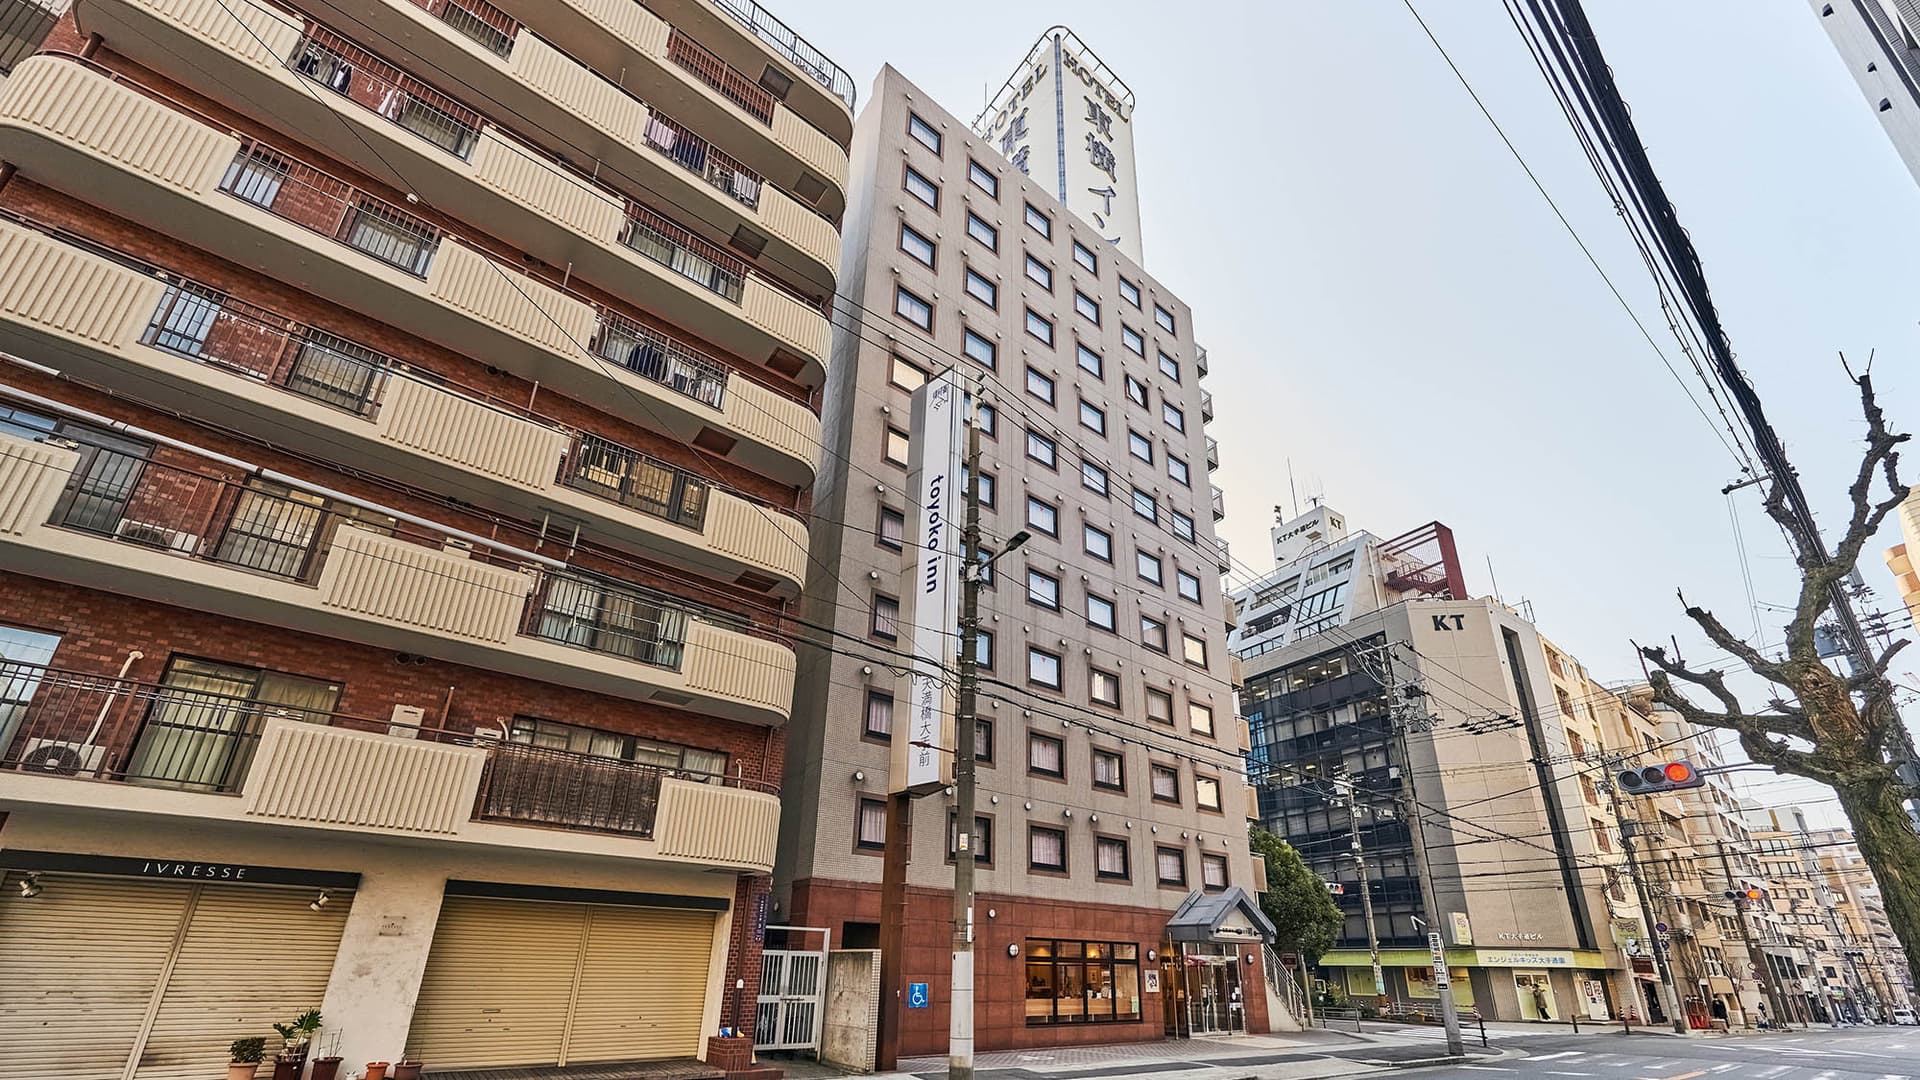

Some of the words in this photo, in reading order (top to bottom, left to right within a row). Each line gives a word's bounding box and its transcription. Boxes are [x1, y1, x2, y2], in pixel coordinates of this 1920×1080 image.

[982, 63, 1048, 143] HOTEL
[1062, 48, 1130, 123] HOTEL
[925, 475, 944, 551] toyoko
[1329, 515, 1342, 530] KT
[926, 554, 942, 594] inn
[1432, 614, 1465, 631] KT
[143, 862, 247, 879] IVRESSE
